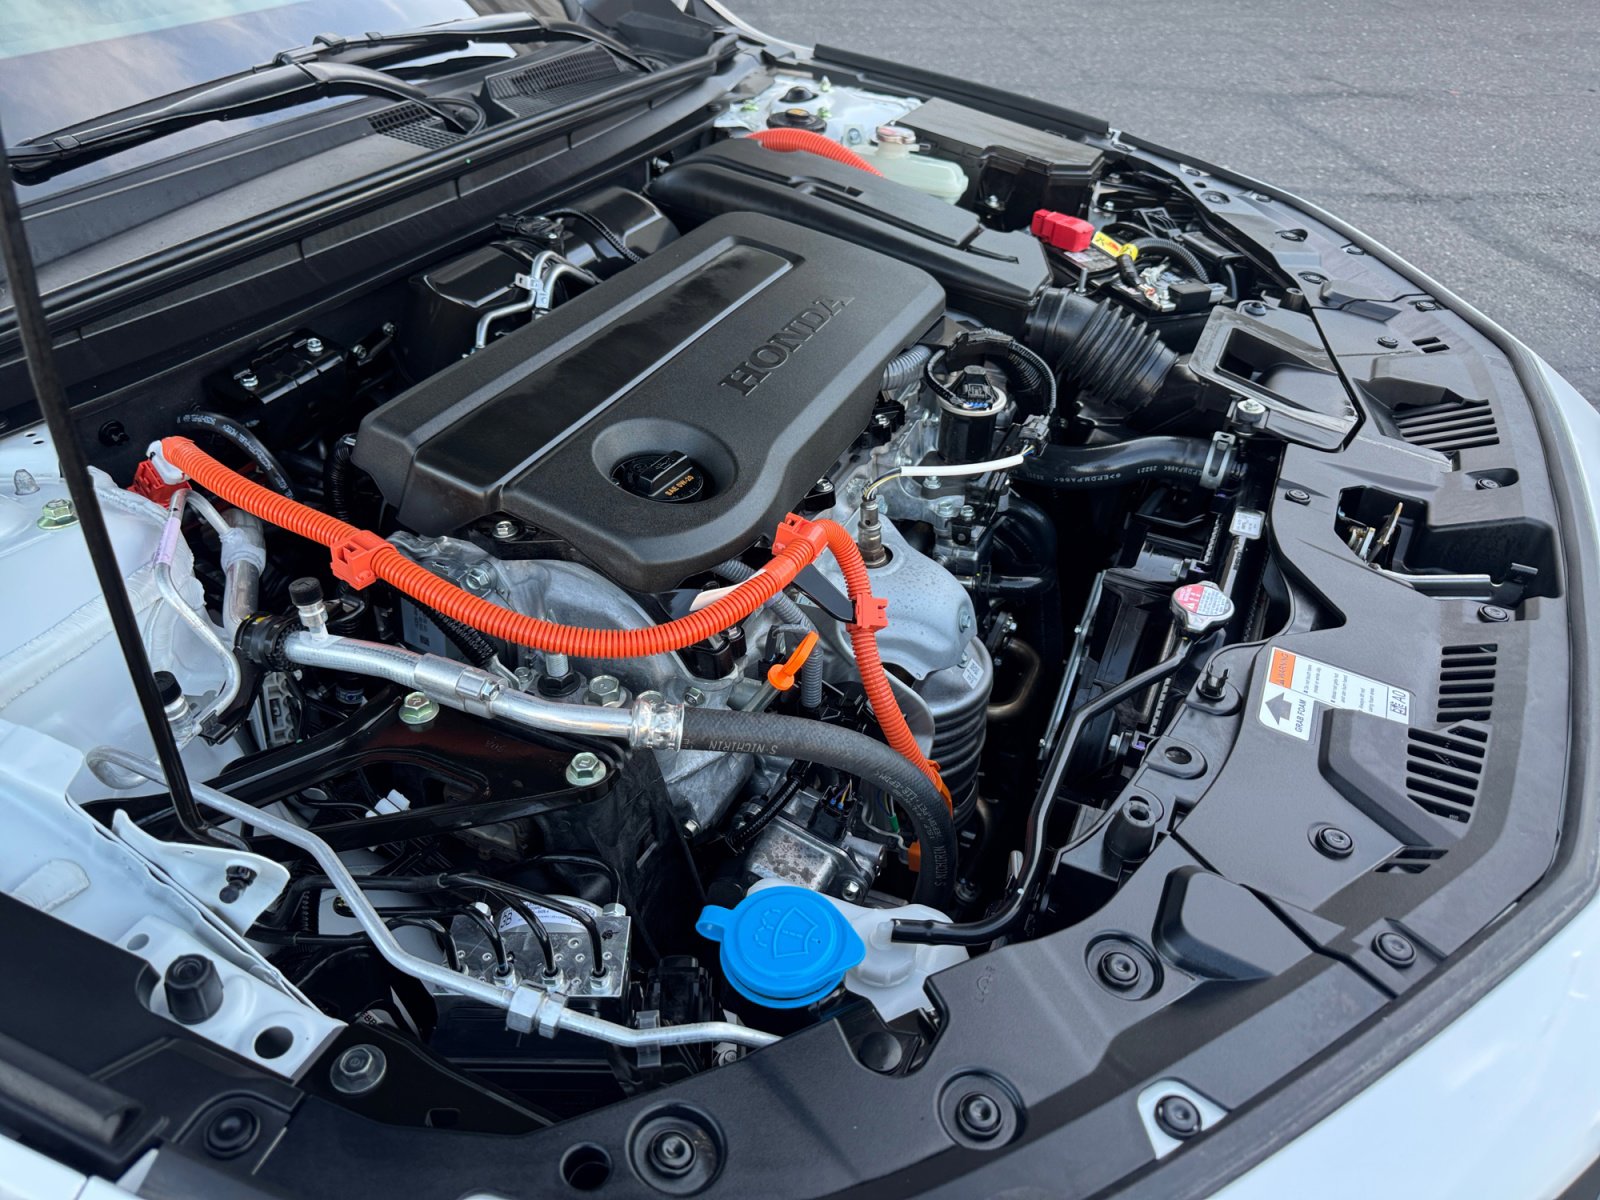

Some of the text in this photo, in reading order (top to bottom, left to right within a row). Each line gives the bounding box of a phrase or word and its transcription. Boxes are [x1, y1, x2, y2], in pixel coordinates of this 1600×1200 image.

[718, 296, 855, 397] HONDA
[1295, 699, 1307, 733] GRAB FOAM
